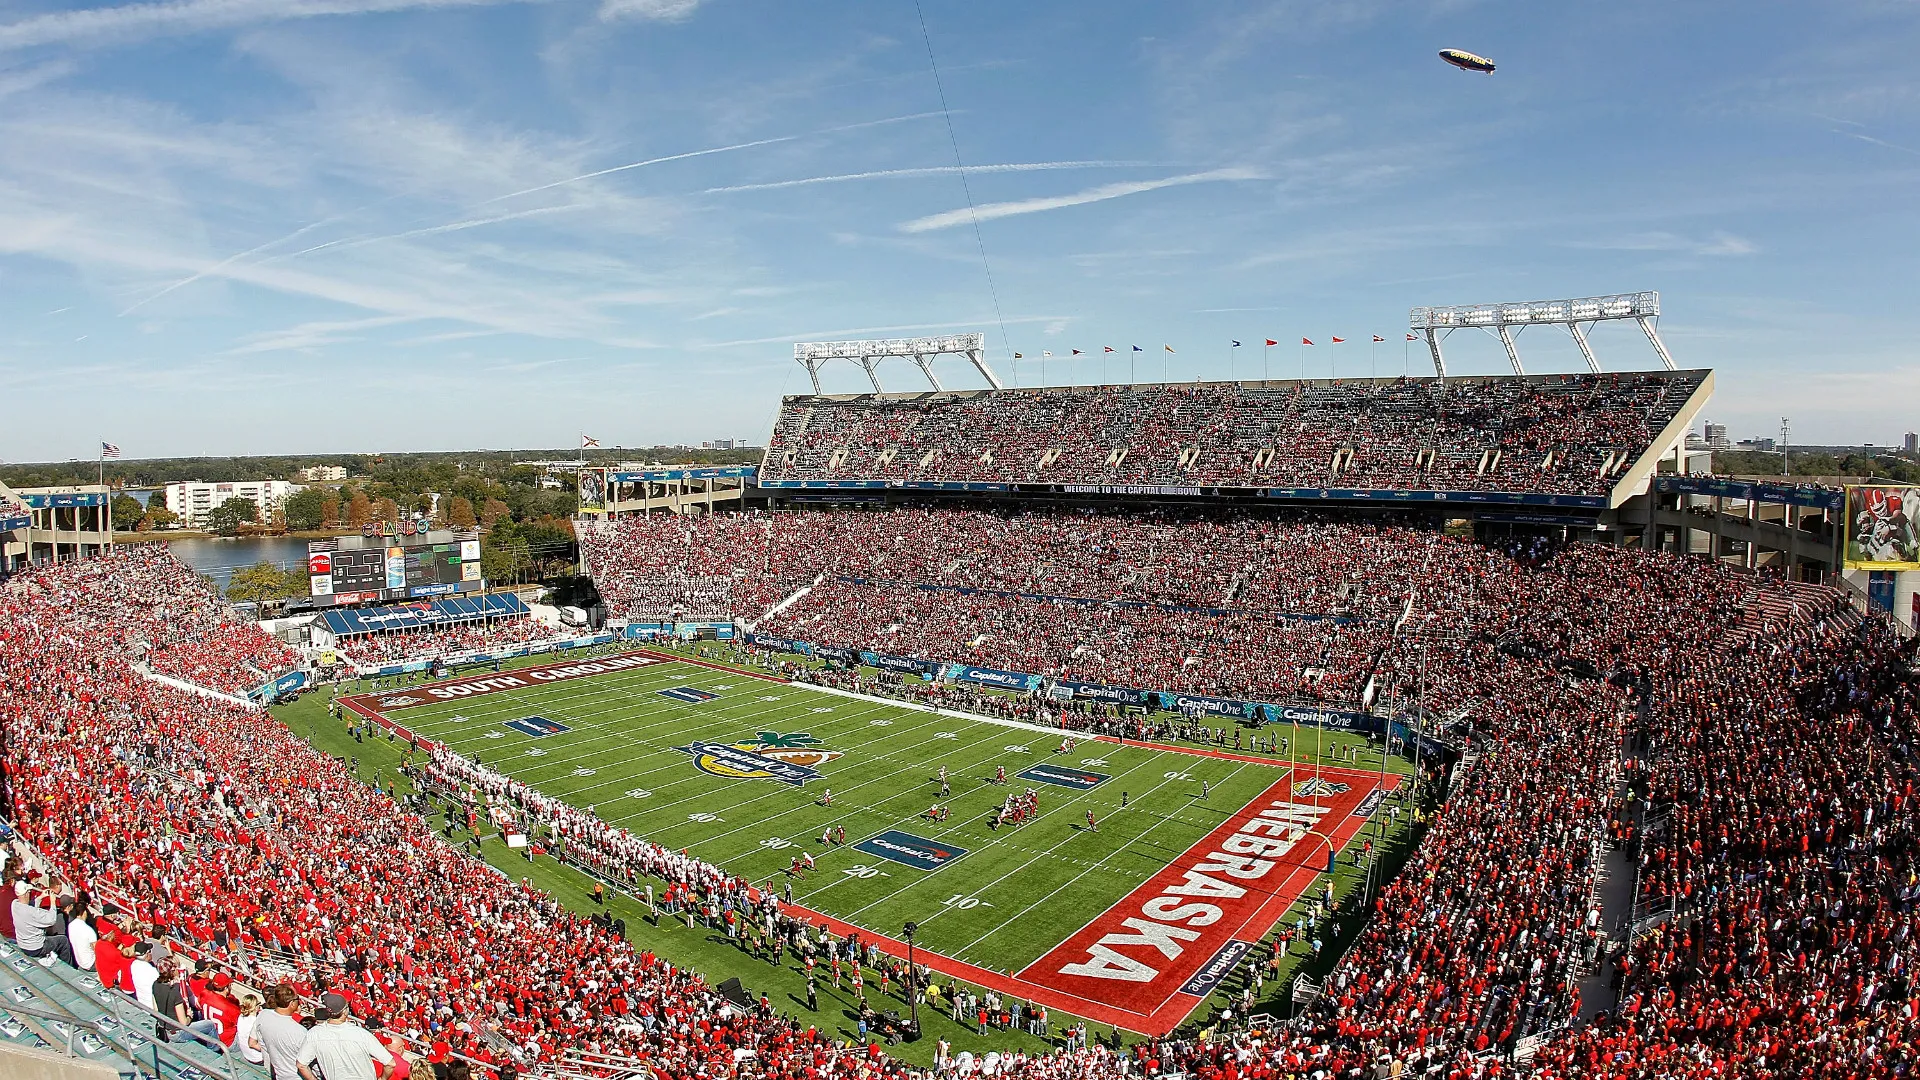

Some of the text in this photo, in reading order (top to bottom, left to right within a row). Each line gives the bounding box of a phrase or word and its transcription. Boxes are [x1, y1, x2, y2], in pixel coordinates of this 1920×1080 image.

[1450, 51, 1486, 65] GOODYEAR
[1064, 485, 1100, 493] WELCOME
[1112, 486, 1127, 494] THE
[1128, 486, 1160, 494] CAPITAL
[1178, 487, 1202, 496] BOWL
[362, 519, 429, 542] ORLANDO
[428, 676, 528, 700] SOUTH
[529, 655, 661, 682] CAROLINA
[843, 864, 879, 879] 20
[1058, 800, 1331, 983] NEBRASKA
[941, 894, 980, 910] 10
